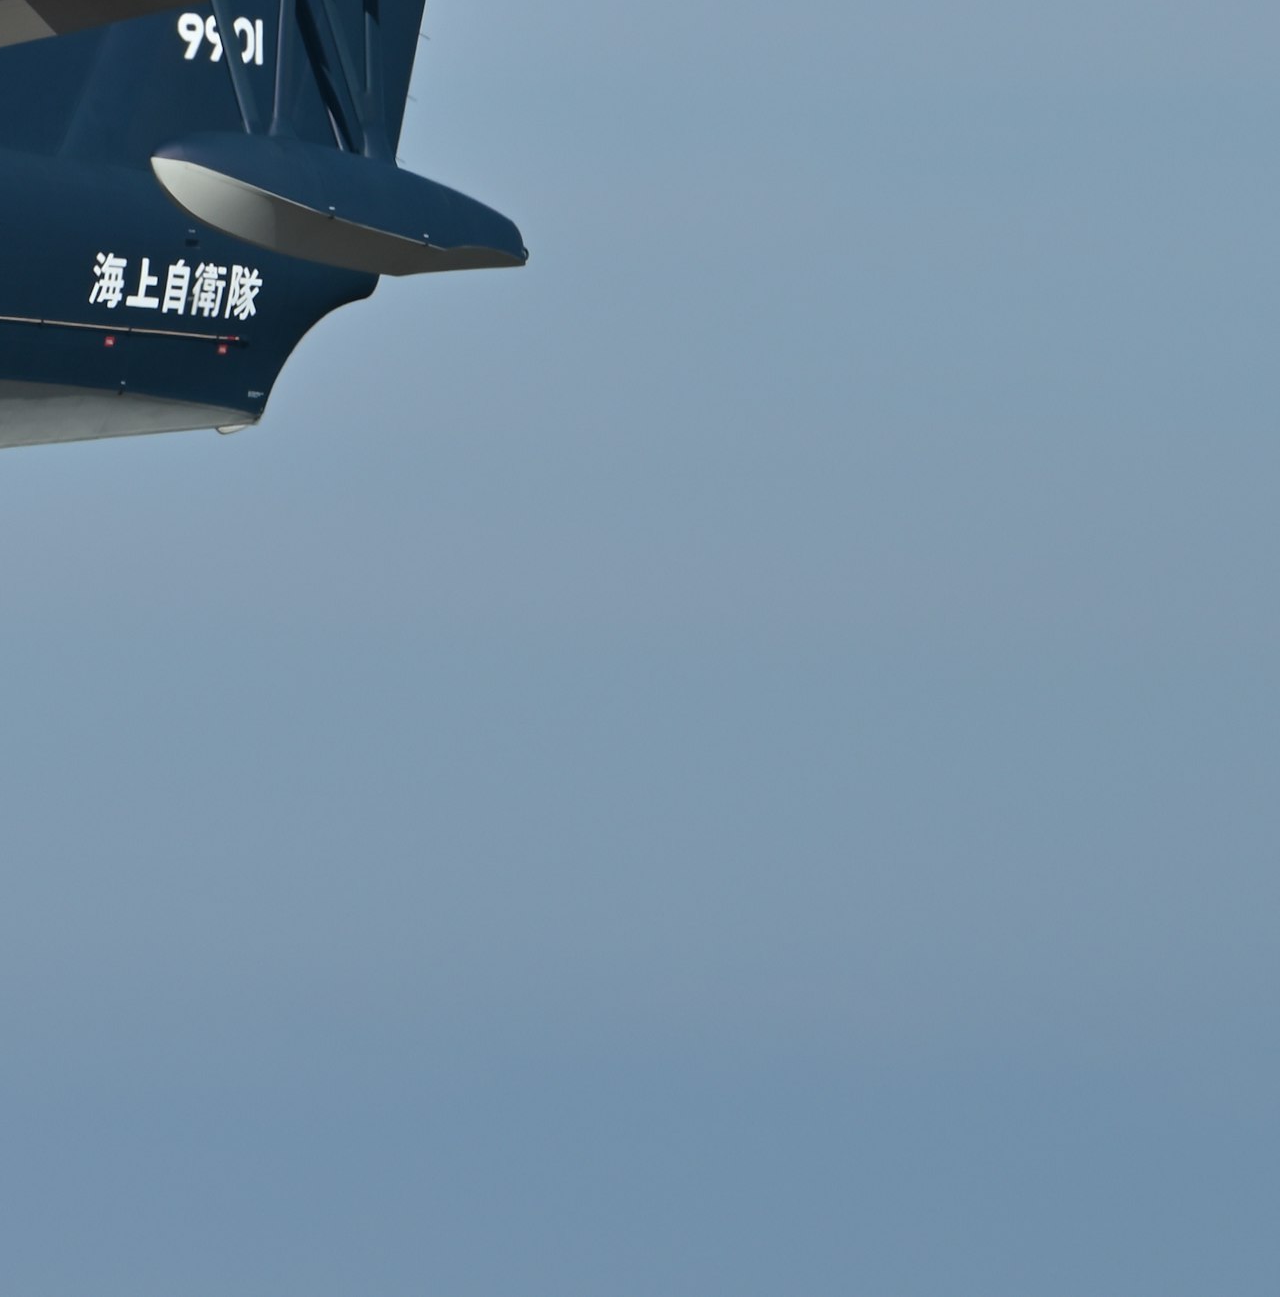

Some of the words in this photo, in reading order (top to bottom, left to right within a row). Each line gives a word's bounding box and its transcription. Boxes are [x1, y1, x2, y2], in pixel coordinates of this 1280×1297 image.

[88, 251, 263, 321] 海上自衛隊
